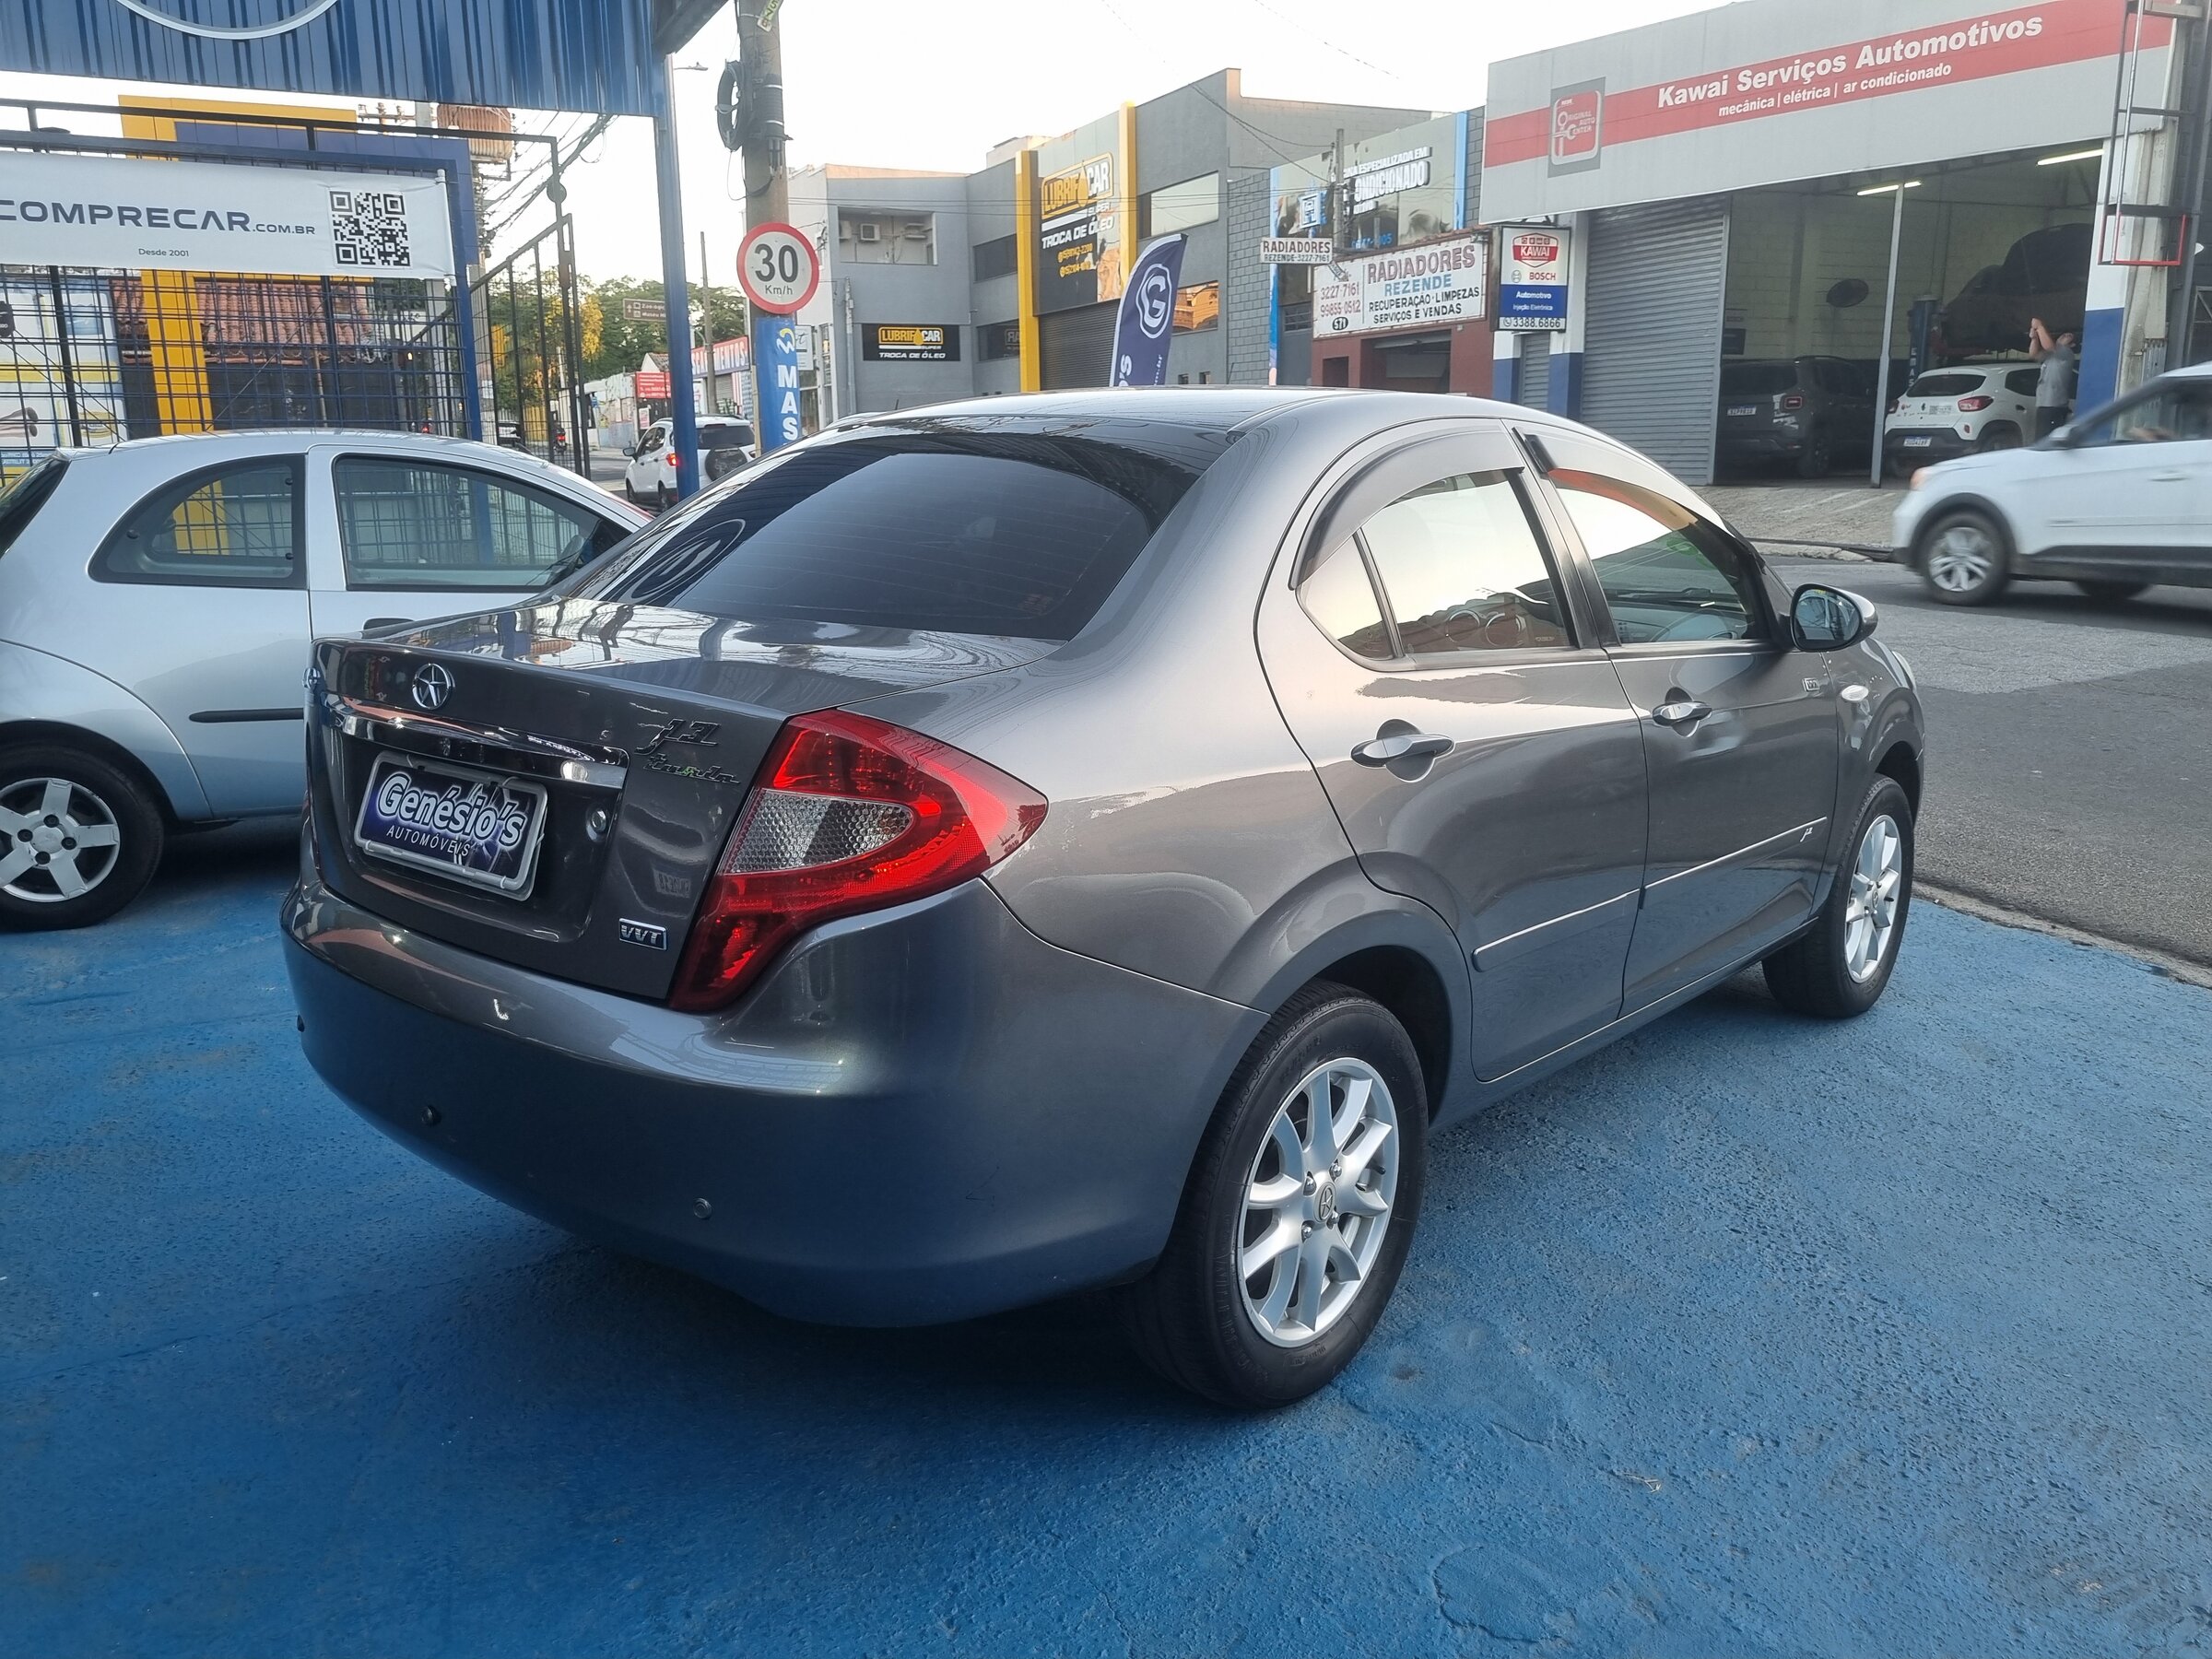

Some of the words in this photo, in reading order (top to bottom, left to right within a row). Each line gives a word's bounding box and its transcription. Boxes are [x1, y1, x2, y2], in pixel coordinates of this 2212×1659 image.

[1658, 74, 1728, 109] Kawai
[1736, 54, 1847, 85] Serviços
[1855, 16, 2043, 70] Automotivos
[1718, 96, 1775, 117] mecânica
[1783, 87, 1831, 105] elétrica
[1842, 79, 1857, 94] ar
[1860, 62, 1952, 91] condicionado
[1041, 232, 1073, 250] TROCA
[1073, 223, 1088, 241] DE
[1088, 215, 1114, 238] ÓLEO
[138, 248, 167, 257] Desde
[169, 249, 190, 257] 2001
[1263, 241, 1331, 254] RADIADORES
[1520, 246, 1550, 256] KAWAI
[754, 243, 799, 284] 30
[1367, 244, 1476, 285] RADIADORES
[1383, 274, 1453, 298] REZENDE
[1528, 272, 1557, 281] BOSCH
[764, 284, 794, 296] Km/h
[1434, 287, 1480, 303] LIMPEZAS
[1372, 312, 1412, 324] SERVIÇOS
[1414, 309, 1420, 319] E
[1422, 303, 1463, 318] VENDAS
[922, 350, 946, 359] ÓLEO
[378, 772, 528, 848] Genésio's
[385, 825, 471, 857] AUTOMÓVEIS
[620, 924, 662, 945] VVT
